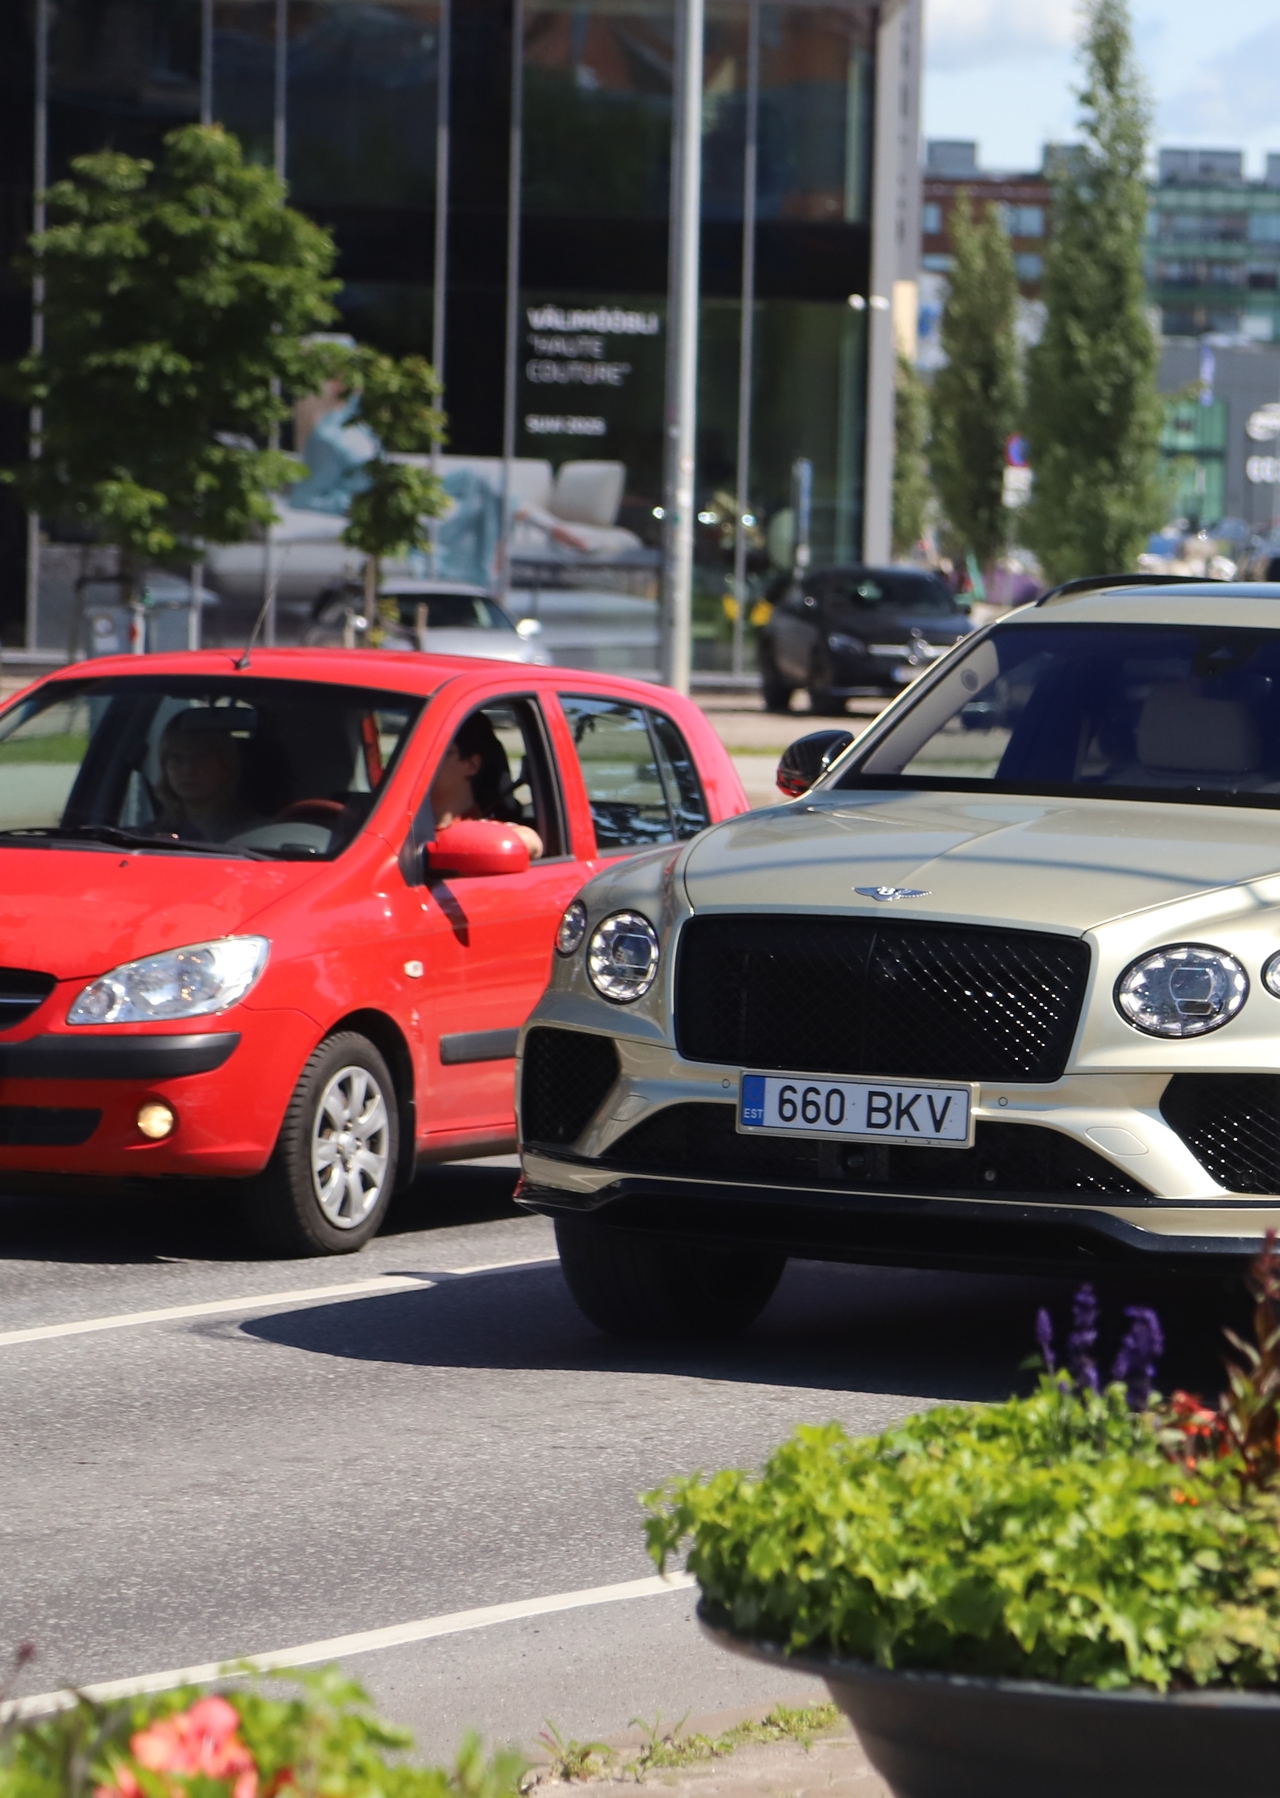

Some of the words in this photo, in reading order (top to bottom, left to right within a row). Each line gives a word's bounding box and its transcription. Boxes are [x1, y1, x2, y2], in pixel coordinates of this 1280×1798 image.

[744, 1108, 763, 1119] EST
[778, 1085, 845, 1125] 660
[866, 1090, 952, 1133] BKV
